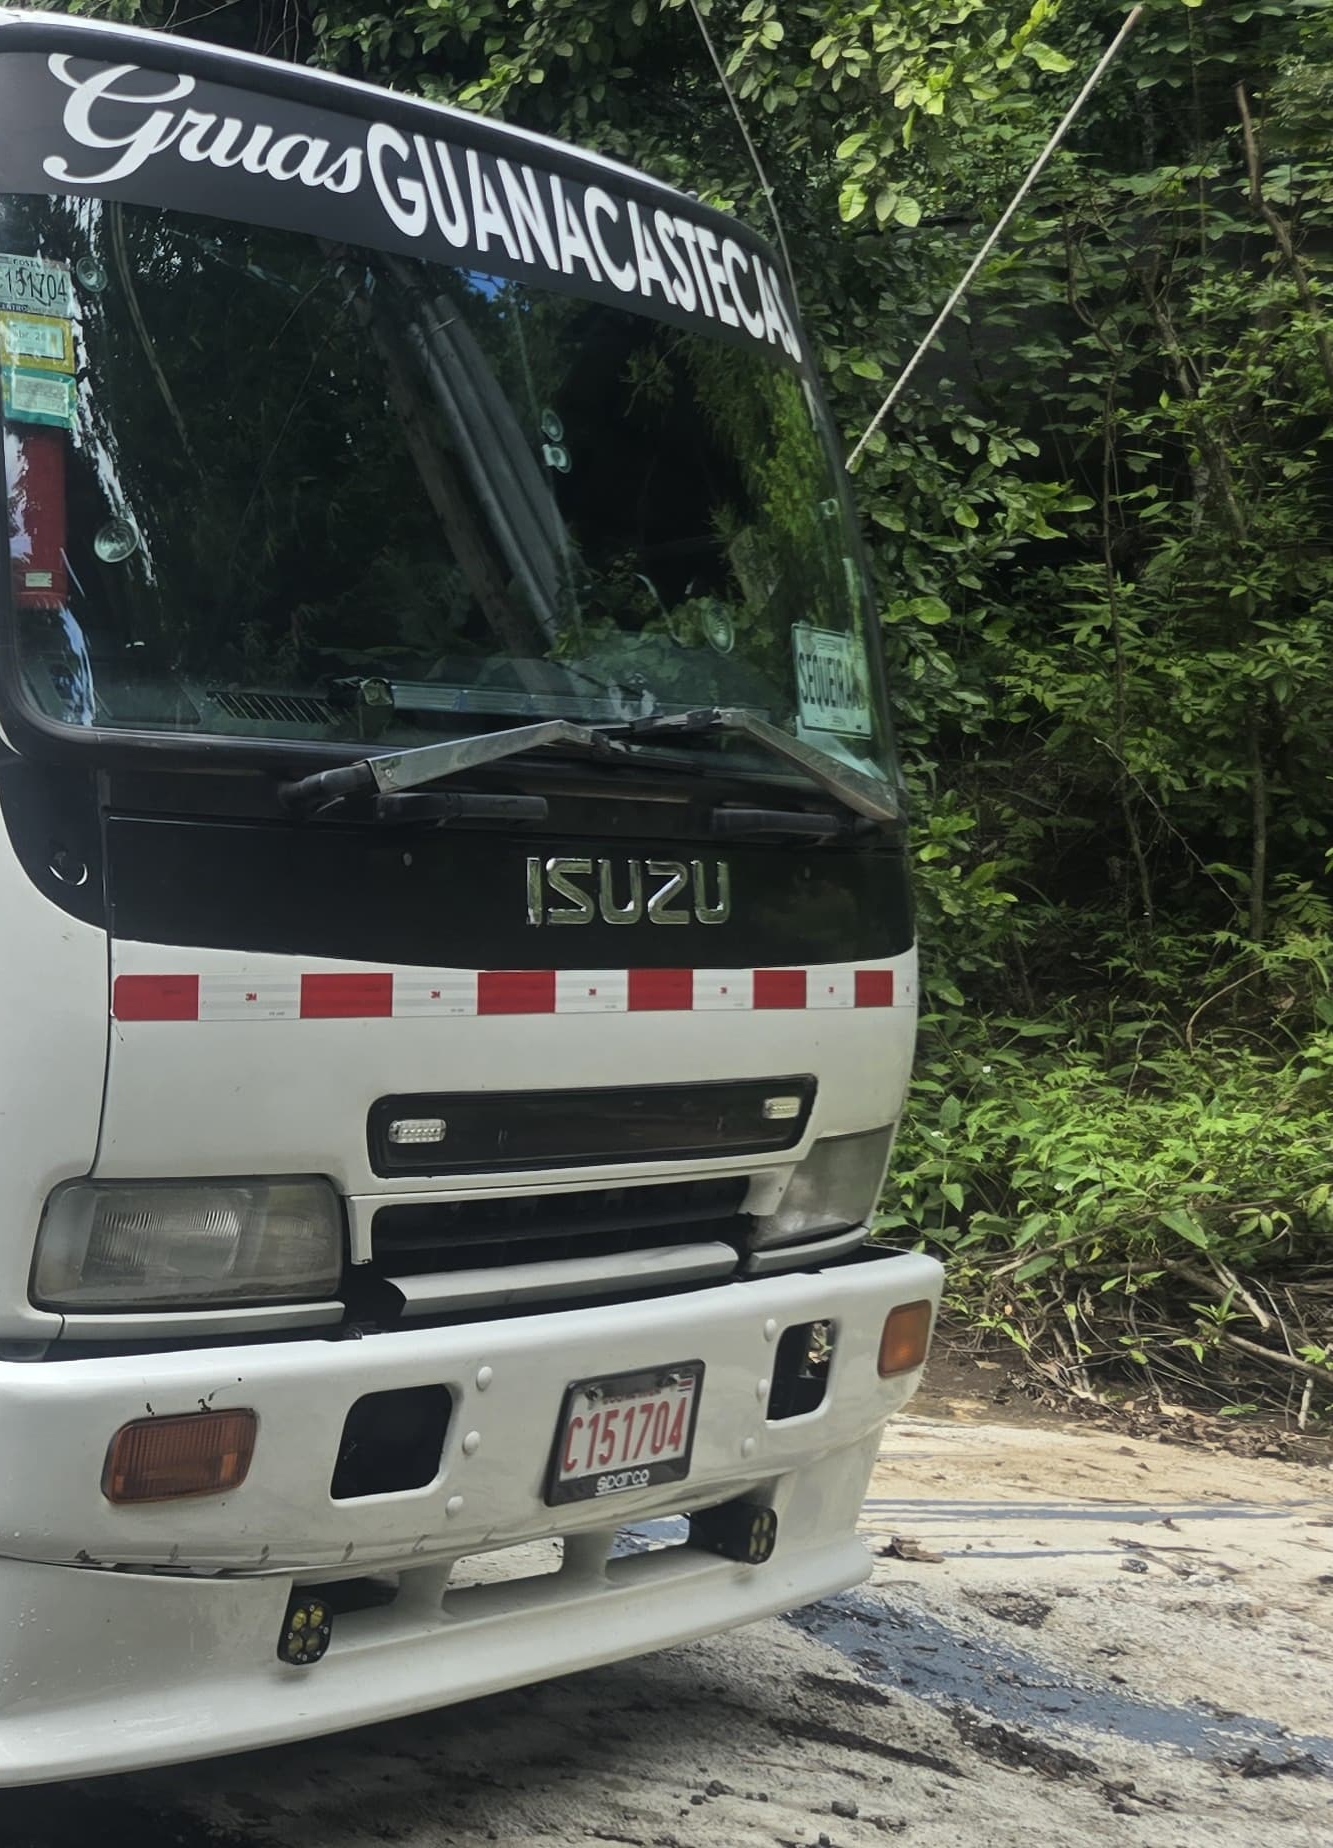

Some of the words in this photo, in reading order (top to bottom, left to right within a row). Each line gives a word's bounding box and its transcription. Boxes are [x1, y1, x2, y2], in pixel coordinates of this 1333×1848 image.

[43, 53, 363, 193] Gruas
[367, 123, 801, 363] GUANACASTECAS
[526, 857, 731, 925] ISUZU
[564, 1397, 687, 1473] C151704
[596, 1469, 650, 1493] sparco
